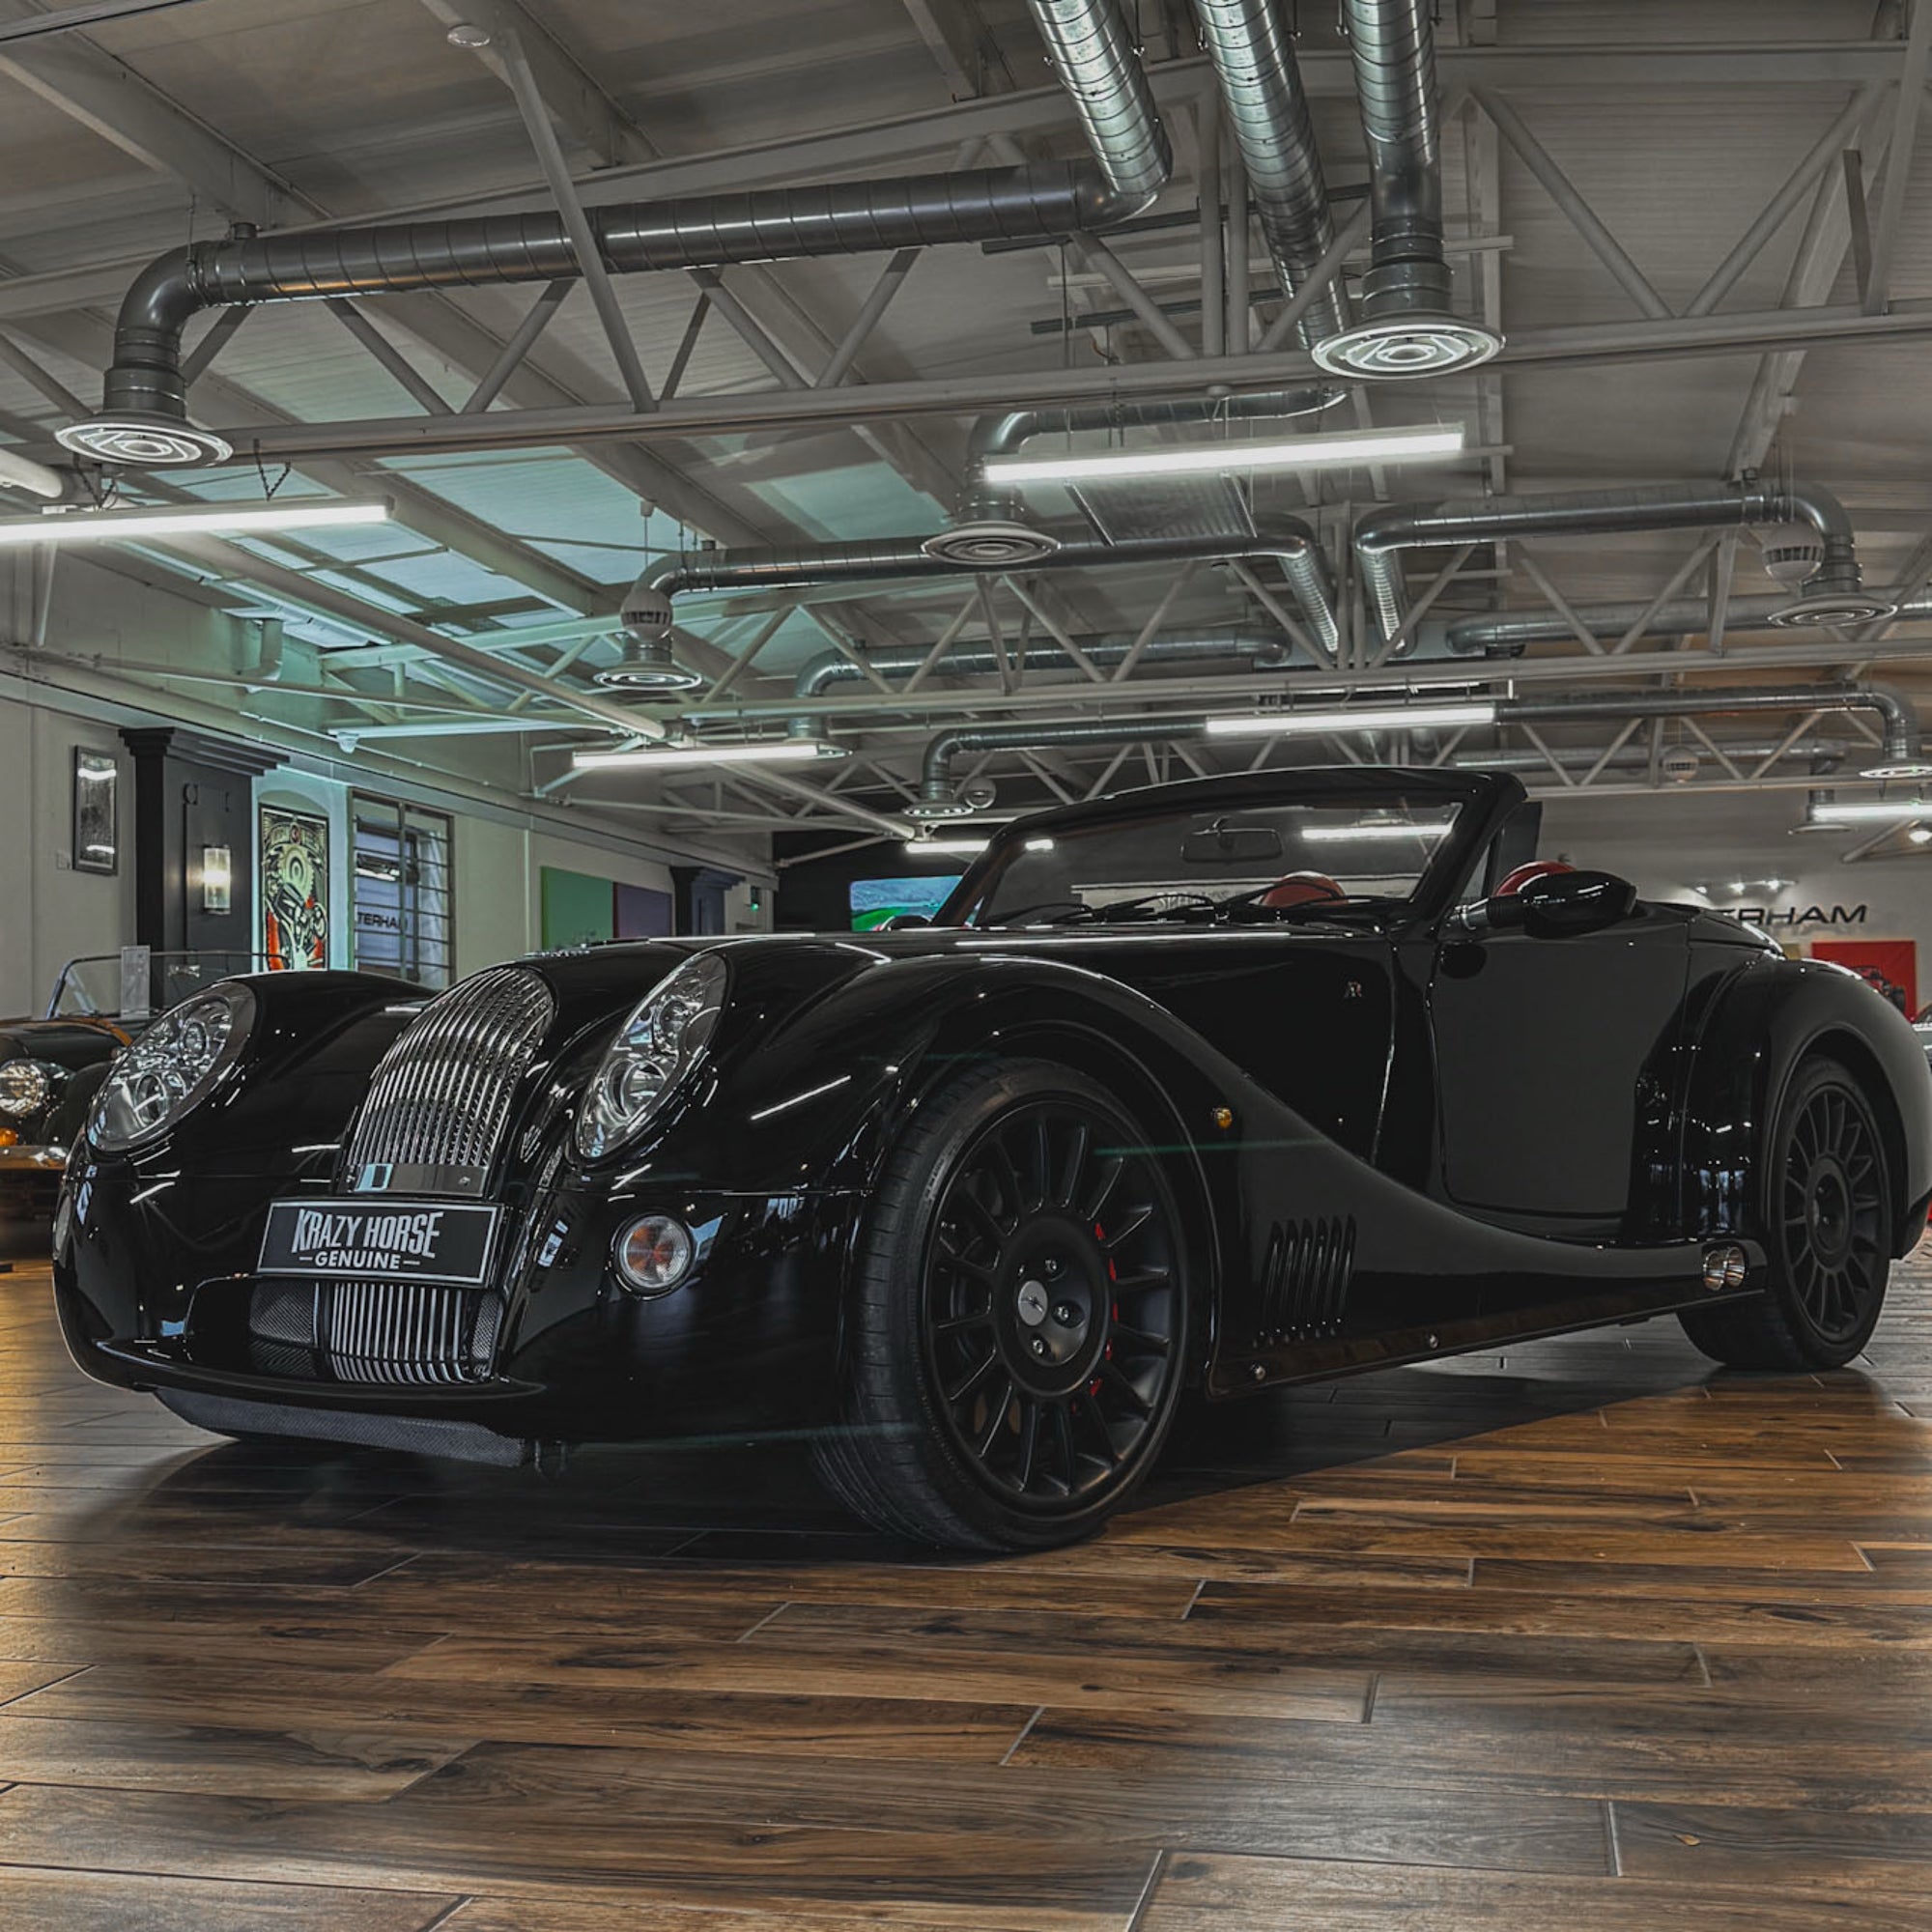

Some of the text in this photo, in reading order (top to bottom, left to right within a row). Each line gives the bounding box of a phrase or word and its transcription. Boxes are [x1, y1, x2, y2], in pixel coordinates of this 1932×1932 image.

[292, 1208, 444, 1259] KRAZY HORSE
[314, 1250, 402, 1270] GENUINE
